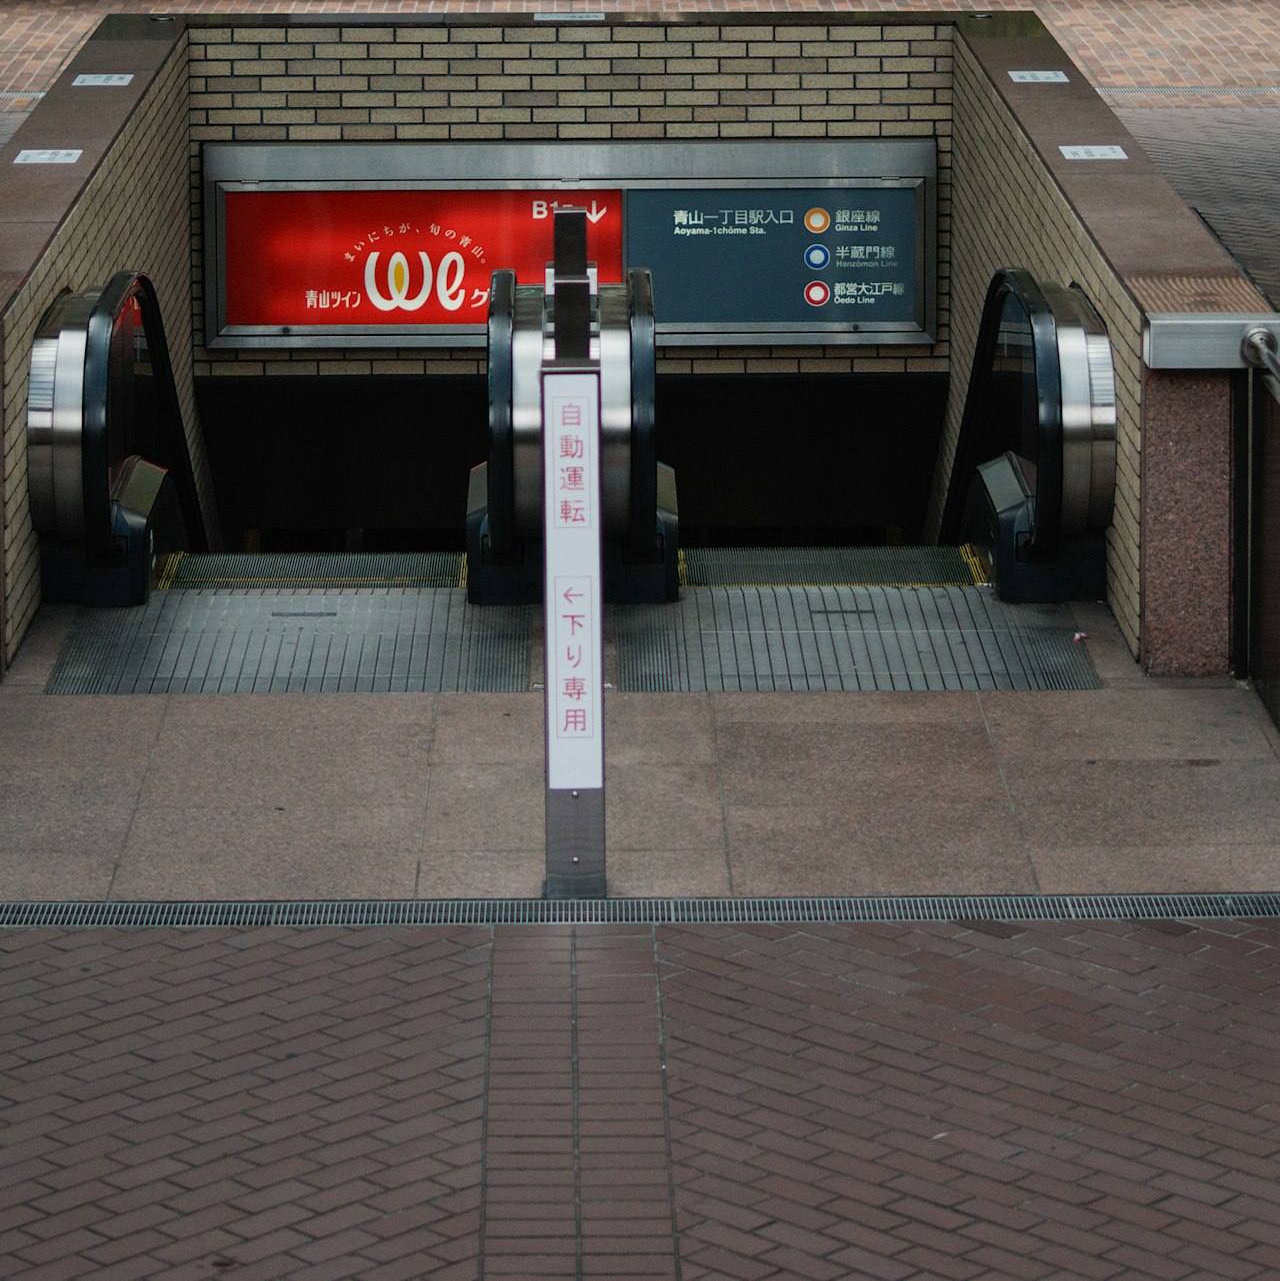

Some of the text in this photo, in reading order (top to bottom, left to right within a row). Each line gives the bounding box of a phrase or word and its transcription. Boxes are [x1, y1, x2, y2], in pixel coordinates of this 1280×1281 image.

[673, 209, 794, 225] 青山一丁目駅入口
[835, 209, 881, 223] 銀座線
[749, 226, 767, 235] Sta.
[835, 223, 878, 232] Ginza Line
[835, 245, 896, 260] 半蔵門線
[833, 282, 905, 296] 都営大江戸線
[305, 289, 361, 309] 青山ツイン
[559, 401, 586, 524] 自動運転
[561, 613, 587, 733] 下り専用
